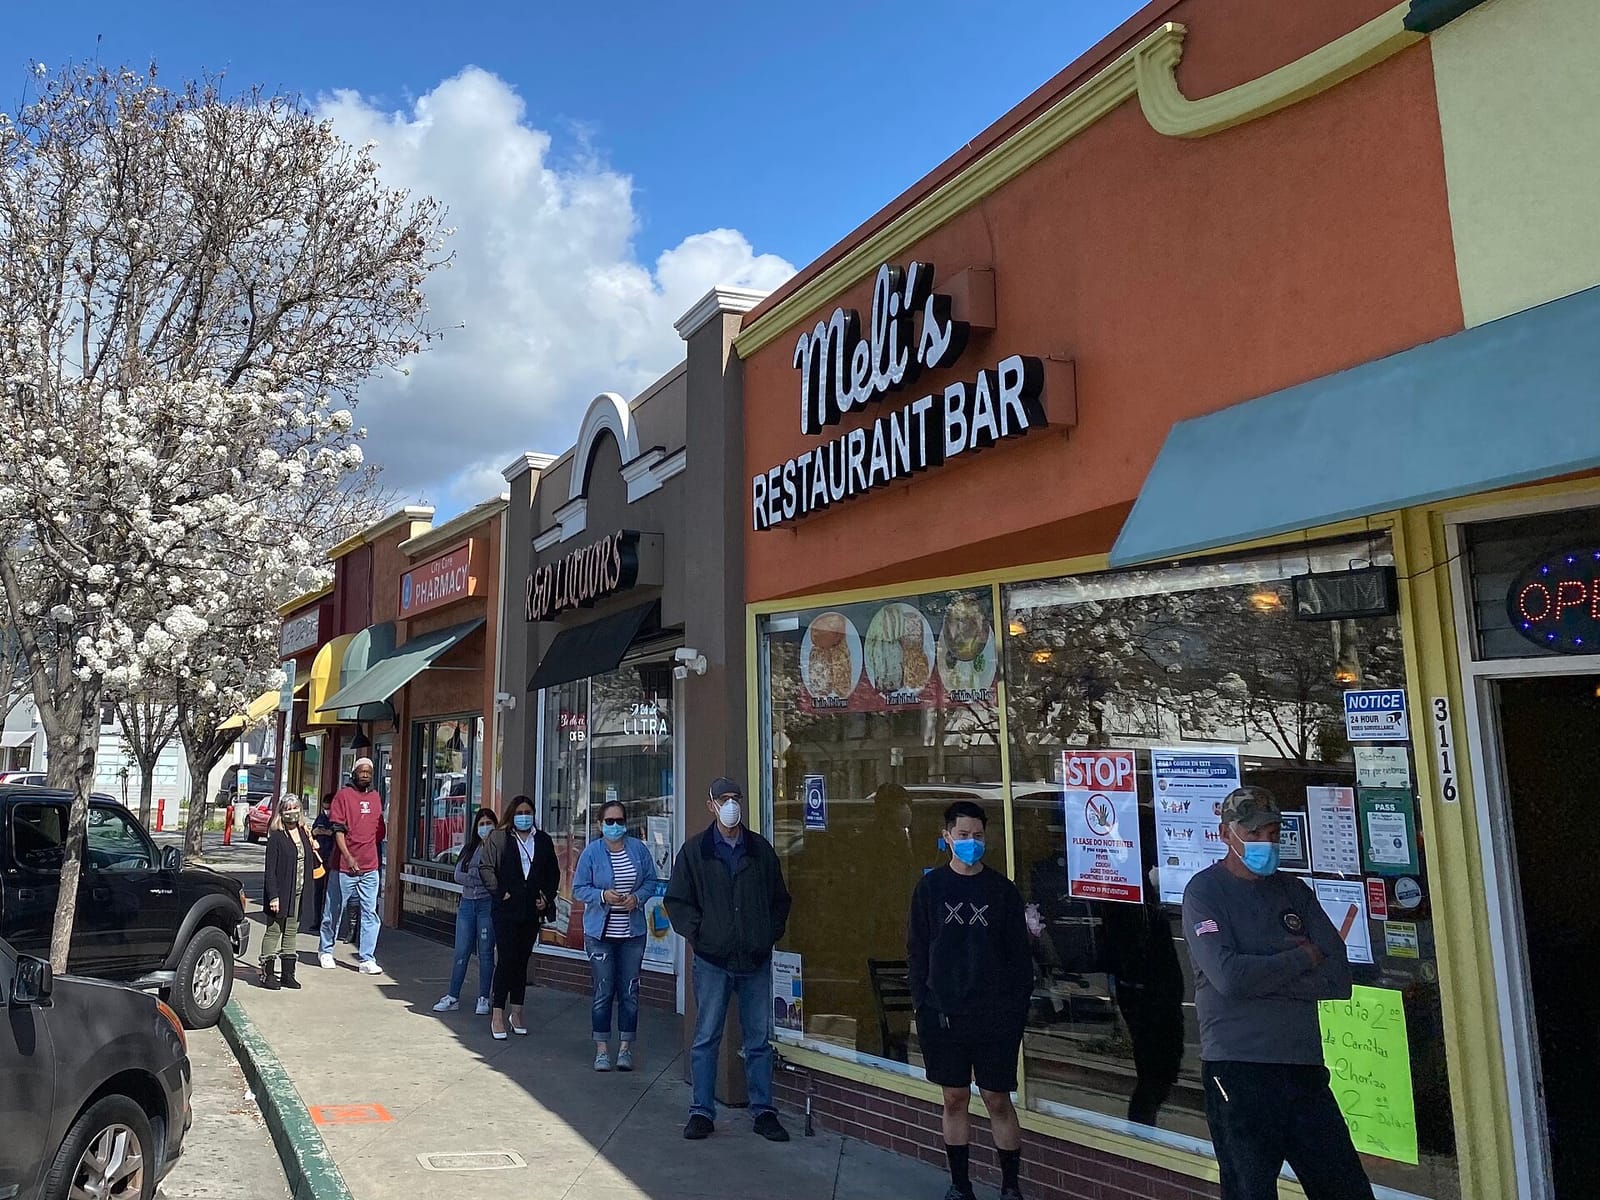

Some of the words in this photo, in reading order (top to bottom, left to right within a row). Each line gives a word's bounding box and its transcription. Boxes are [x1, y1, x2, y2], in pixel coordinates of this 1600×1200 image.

[792, 261, 952, 436] Meli's
[753, 395, 932, 531] RESTAURANT
[943, 354, 1029, 457] BAR
[415, 563, 468, 607] PHARMACY
[555, 529, 623, 610] LIQUORS
[1348, 694, 1401, 709] NOTICE
[1350, 715, 1359, 724] 24
[1360, 715, 1379, 723] HOUR
[1434, 698, 1456, 801] 3116
[1068, 756, 1131, 787] STOP
[1374, 803, 1396, 811] PASS
[1072, 837, 1093, 846] PLEASE
[1103, 839, 1115, 847] NOT
[1116, 840, 1134, 848] ENTER
[1102, 886, 1129, 895] PREVENTION
[1342, 1031, 1388, 1059] Carnitas
[1334, 1057, 1387, 1090] Chorizo
